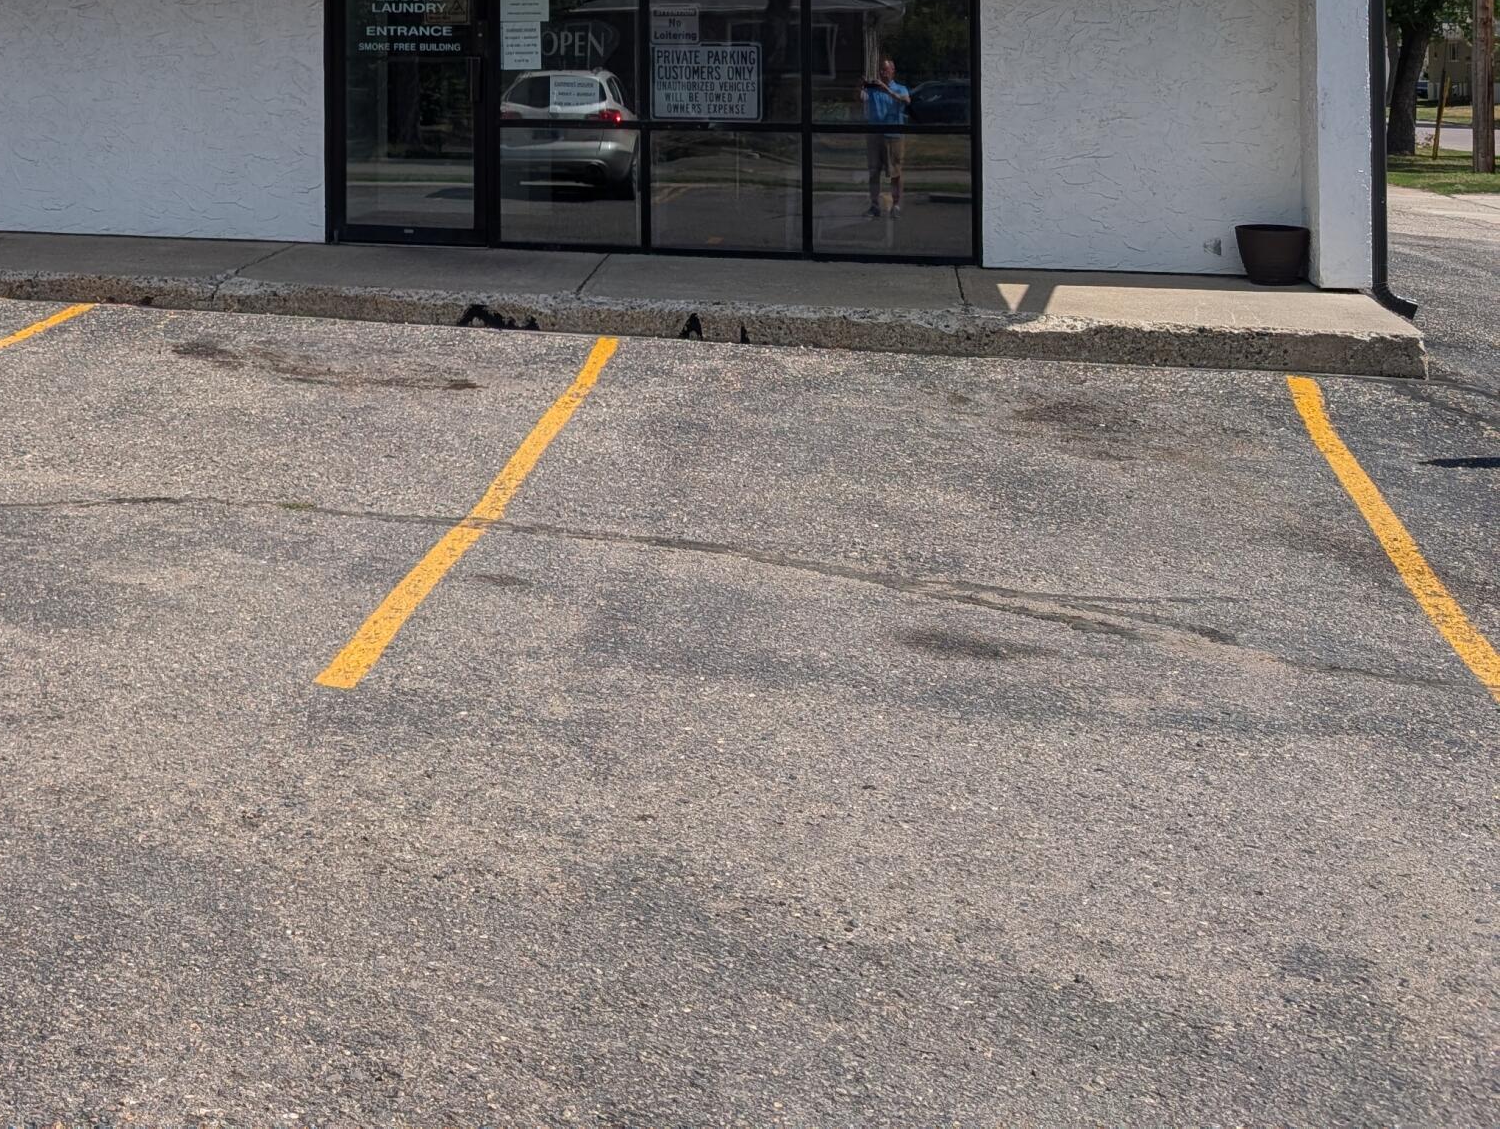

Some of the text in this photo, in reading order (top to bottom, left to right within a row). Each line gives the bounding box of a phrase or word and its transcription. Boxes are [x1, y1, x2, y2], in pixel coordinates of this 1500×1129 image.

[371, 3, 447, 13] LAUNDRY
[668, 18, 682, 28] No
[366, 26, 453, 36] ENTRANCE
[654, 31, 697, 41] Loitering
[358, 42, 461, 51] SMOKE FREE BUILDING
[541, 31, 605, 57] OPEN
[656, 50, 756, 65] PRIVATE PARKING
[657, 66, 754, 80] CUSTOMERS ONLY
[656, 81, 756, 91] UNAUTHORIZED VEHICLES
[664, 93, 747, 102] WILL BE TOWED AT
[707, 104, 745, 114] EXPENSE
